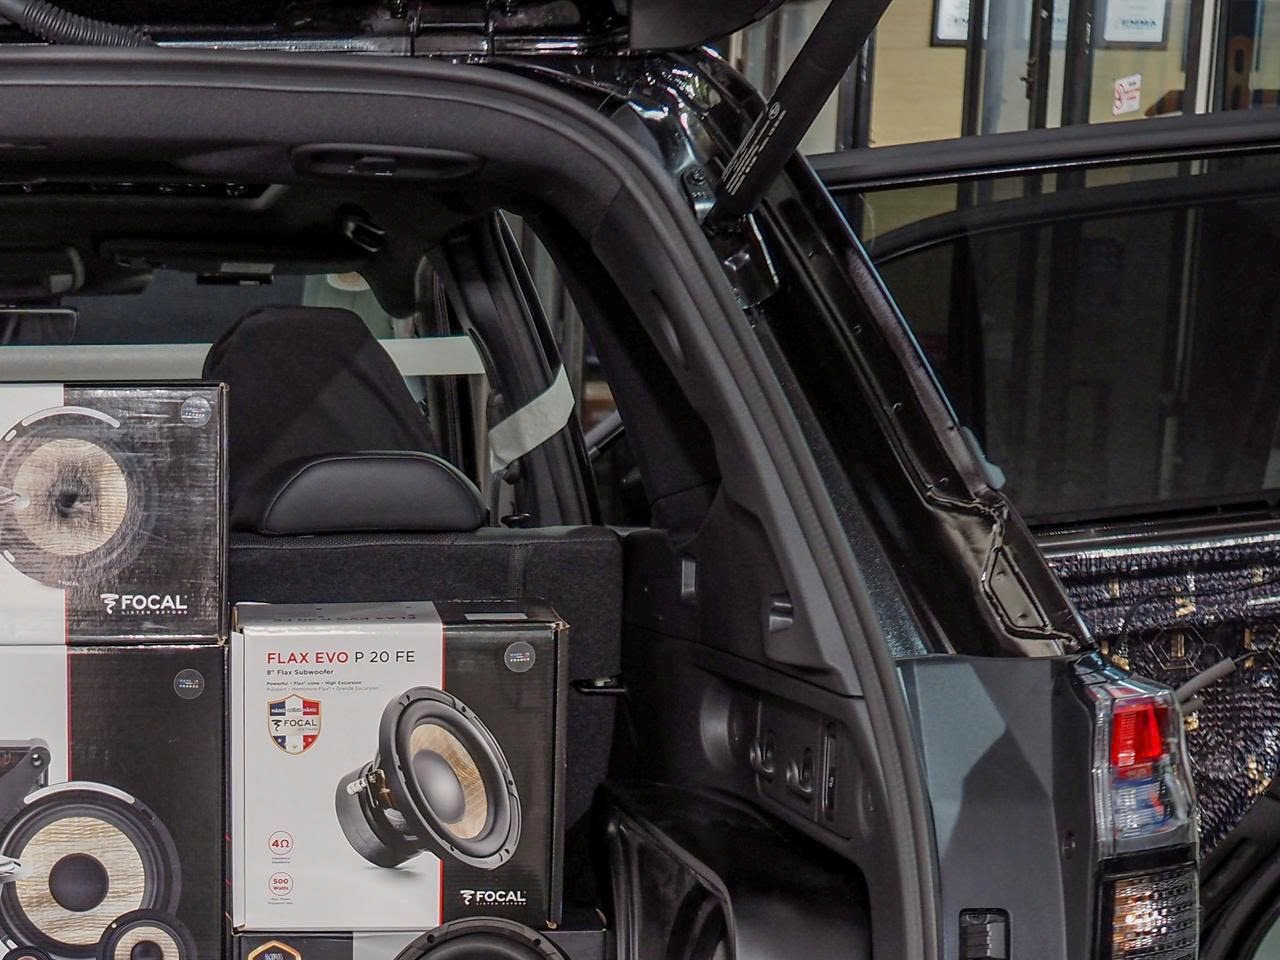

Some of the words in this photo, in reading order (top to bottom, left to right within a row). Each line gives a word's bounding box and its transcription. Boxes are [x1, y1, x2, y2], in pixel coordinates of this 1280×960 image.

[121, 594, 188, 610] FOCAL
[267, 652, 309, 664] FLAX
[315, 651, 349, 663] EVO
[354, 651, 365, 663] P
[370, 651, 390, 663] 20
[395, 651, 415, 662] FE
[294, 668, 334, 676] Subwoofer
[284, 719, 318, 727] FOCAL
[476, 890, 527, 902] FOCAL
